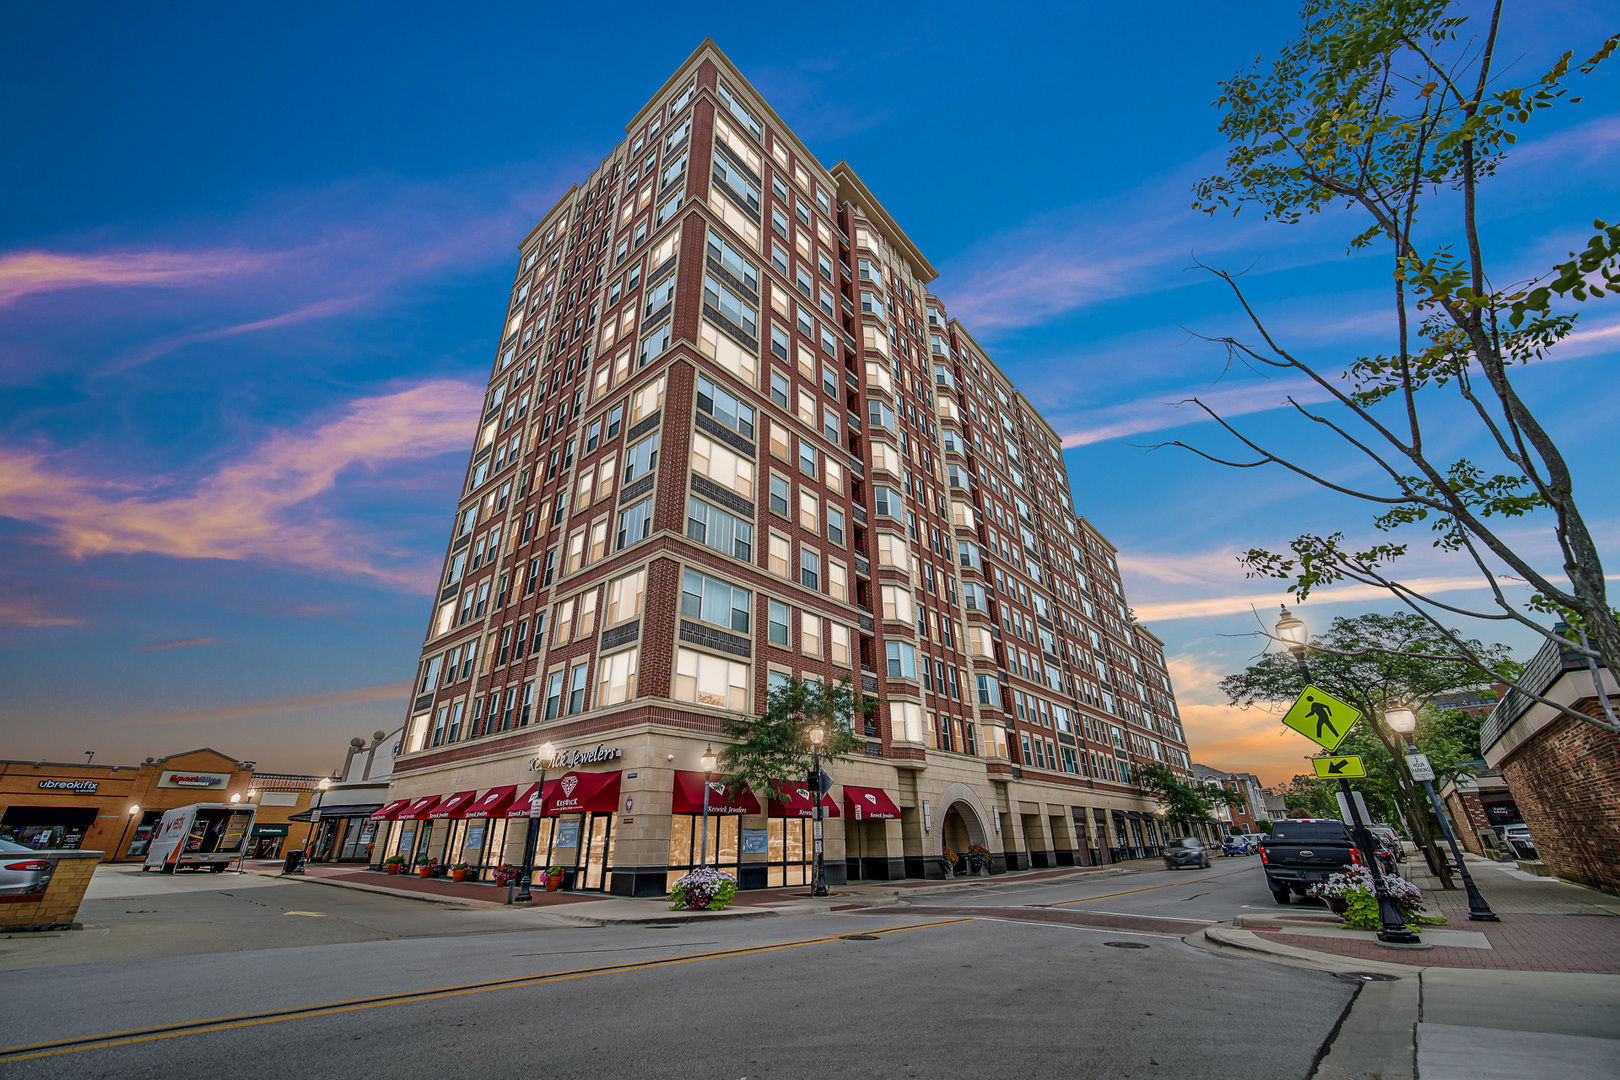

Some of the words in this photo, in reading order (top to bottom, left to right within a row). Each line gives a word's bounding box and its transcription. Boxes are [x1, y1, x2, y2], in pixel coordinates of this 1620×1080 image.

[568, 743, 618, 768] Jewelers
[39, 779, 99, 790] ubreakifix
[556, 798, 578, 807] KESWICK
